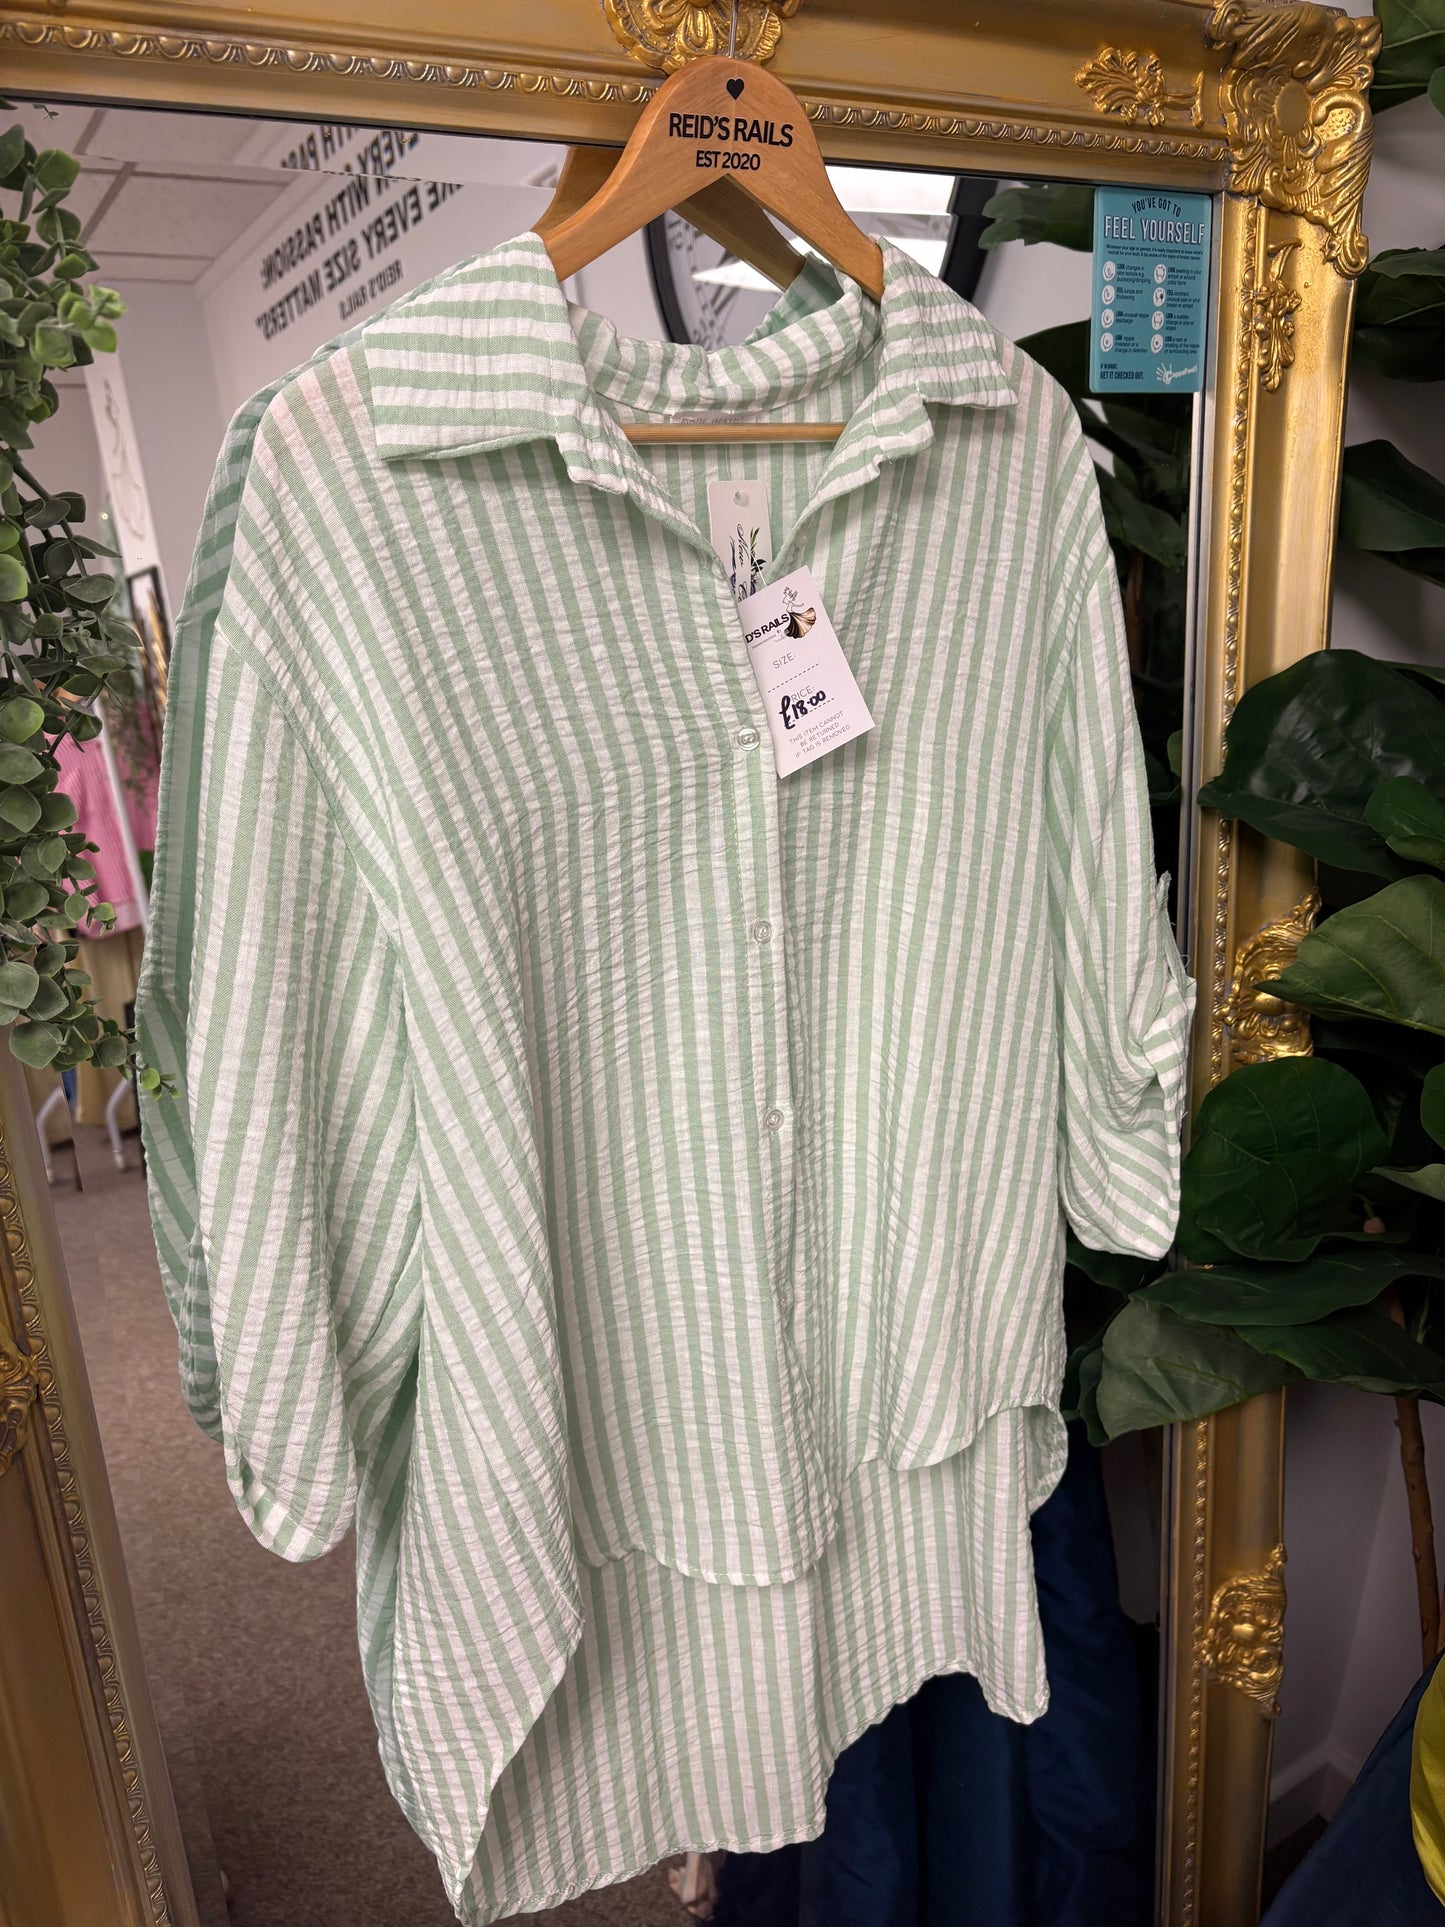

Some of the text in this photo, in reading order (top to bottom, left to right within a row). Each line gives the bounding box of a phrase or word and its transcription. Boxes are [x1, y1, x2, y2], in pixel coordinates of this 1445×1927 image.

[669, 112, 793, 148] REID'S RAILS
[696, 150, 761, 170] EST 2020
[1132, 197, 1182, 217] YOU'VE GOT TO
[1104, 215, 1205, 245] FEEL YOURSELF
[761, 613, 790, 635] RAILS
[772, 652, 797, 669] SIZE:
[787, 685, 816, 704] RICE:
[789, 711, 844, 744] THIS ITEM CANNOT
[800, 722, 840, 747] BE RETURNED
[795, 724, 851, 758] IF TAG IS REMOVED
